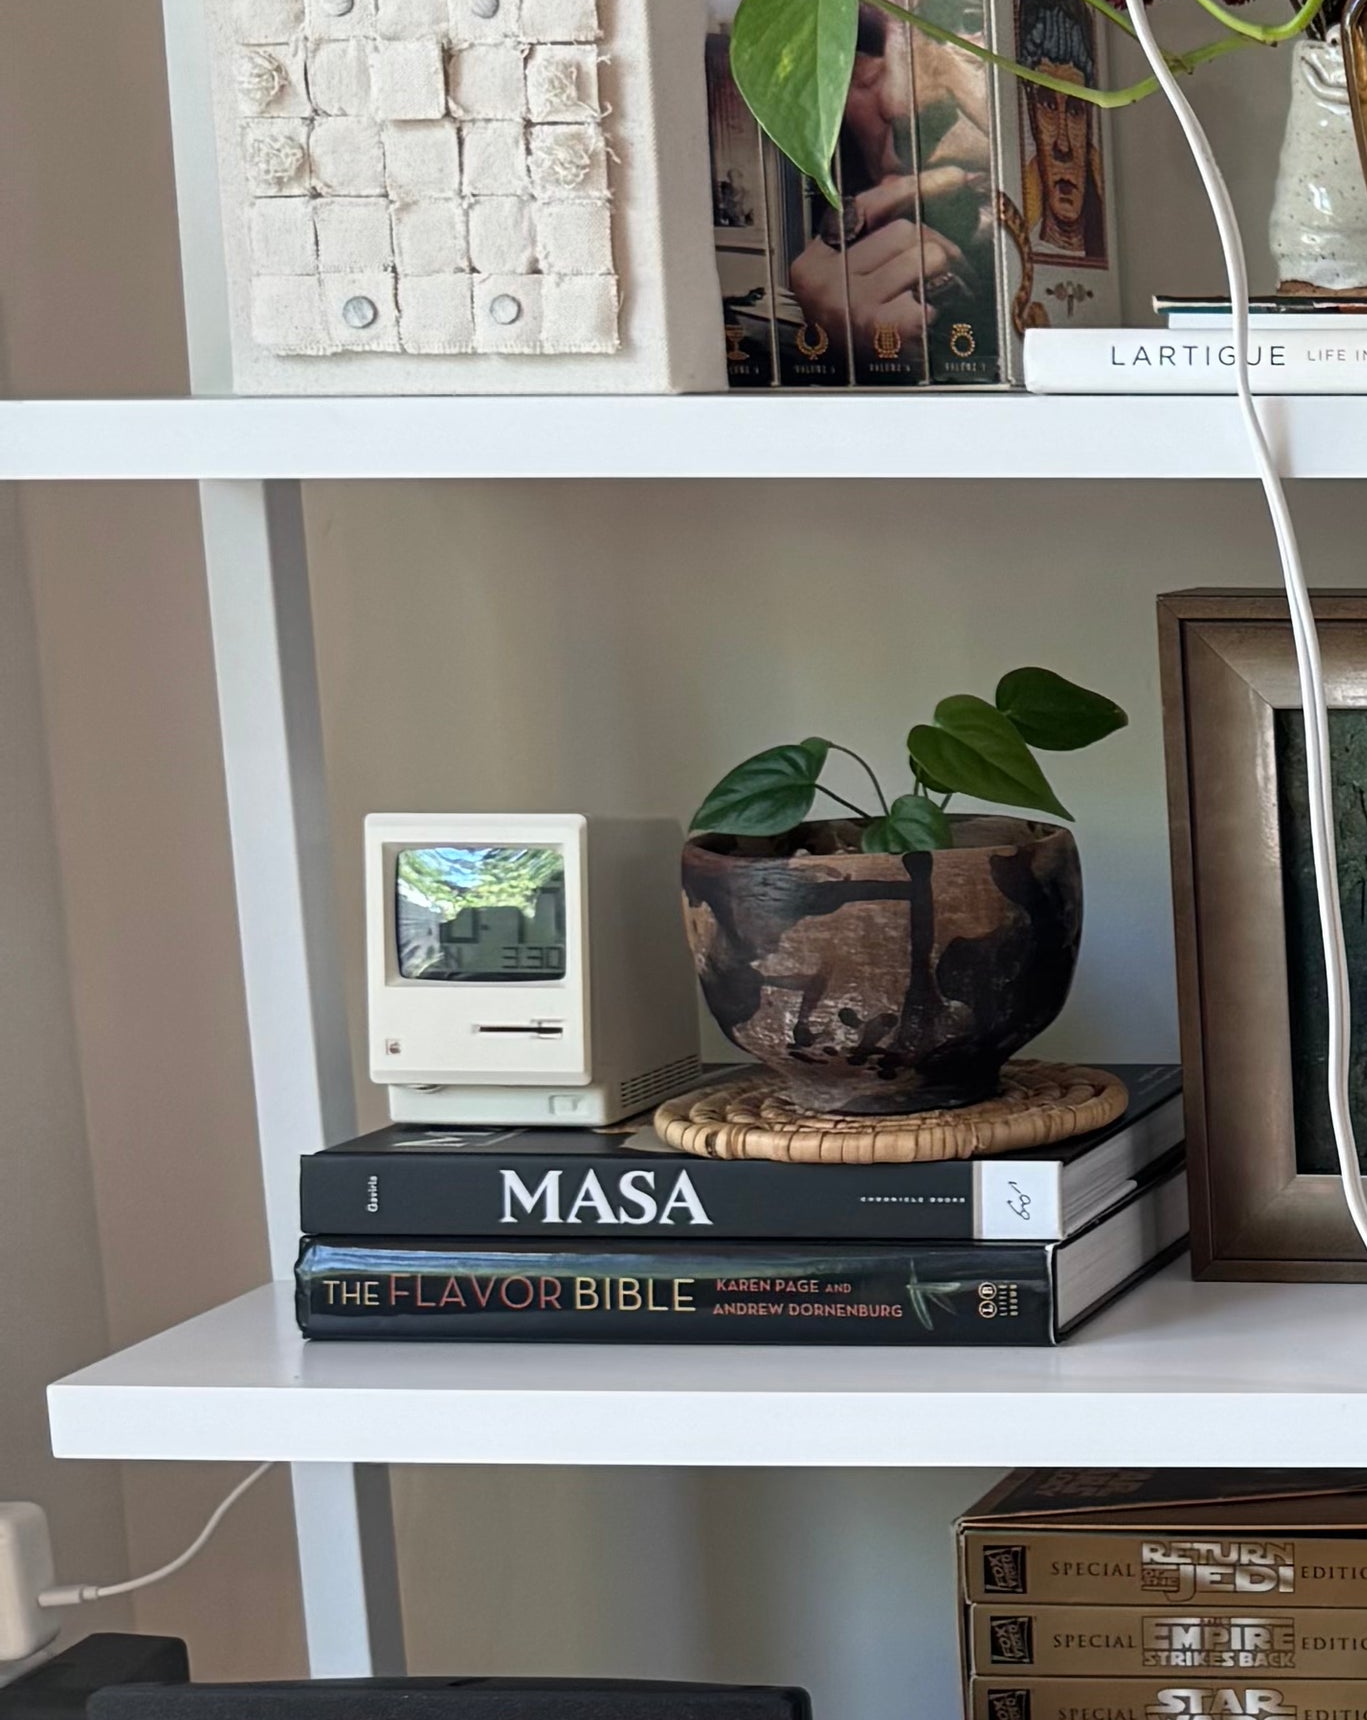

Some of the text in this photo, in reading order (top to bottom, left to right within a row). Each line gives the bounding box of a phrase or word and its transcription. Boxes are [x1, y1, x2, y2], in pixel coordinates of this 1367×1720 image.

[1111, 345, 1287, 367] LARTIGUE
[1307, 349, 1347, 362] LIFE
[499, 1167, 714, 1226] MASA
[323, 1273, 697, 1313] THE FLAVOR BIBLE
[716, 1278, 852, 1294] KAREN PAGE AND
[712, 1303, 904, 1318] ANDREW DORNENBURG
[1141, 1542, 1295, 1565] RETURN
[1051, 1561, 1136, 1578] SPECIAL
[1164, 1564, 1295, 1602] JEDI
[1053, 1634, 1137, 1649] SPECIAL
[1143, 1618, 1295, 1651] EMPIRE
[1144, 1650, 1296, 1668] STRIKES BACK
[1144, 1688, 1298, 1715] STAR
